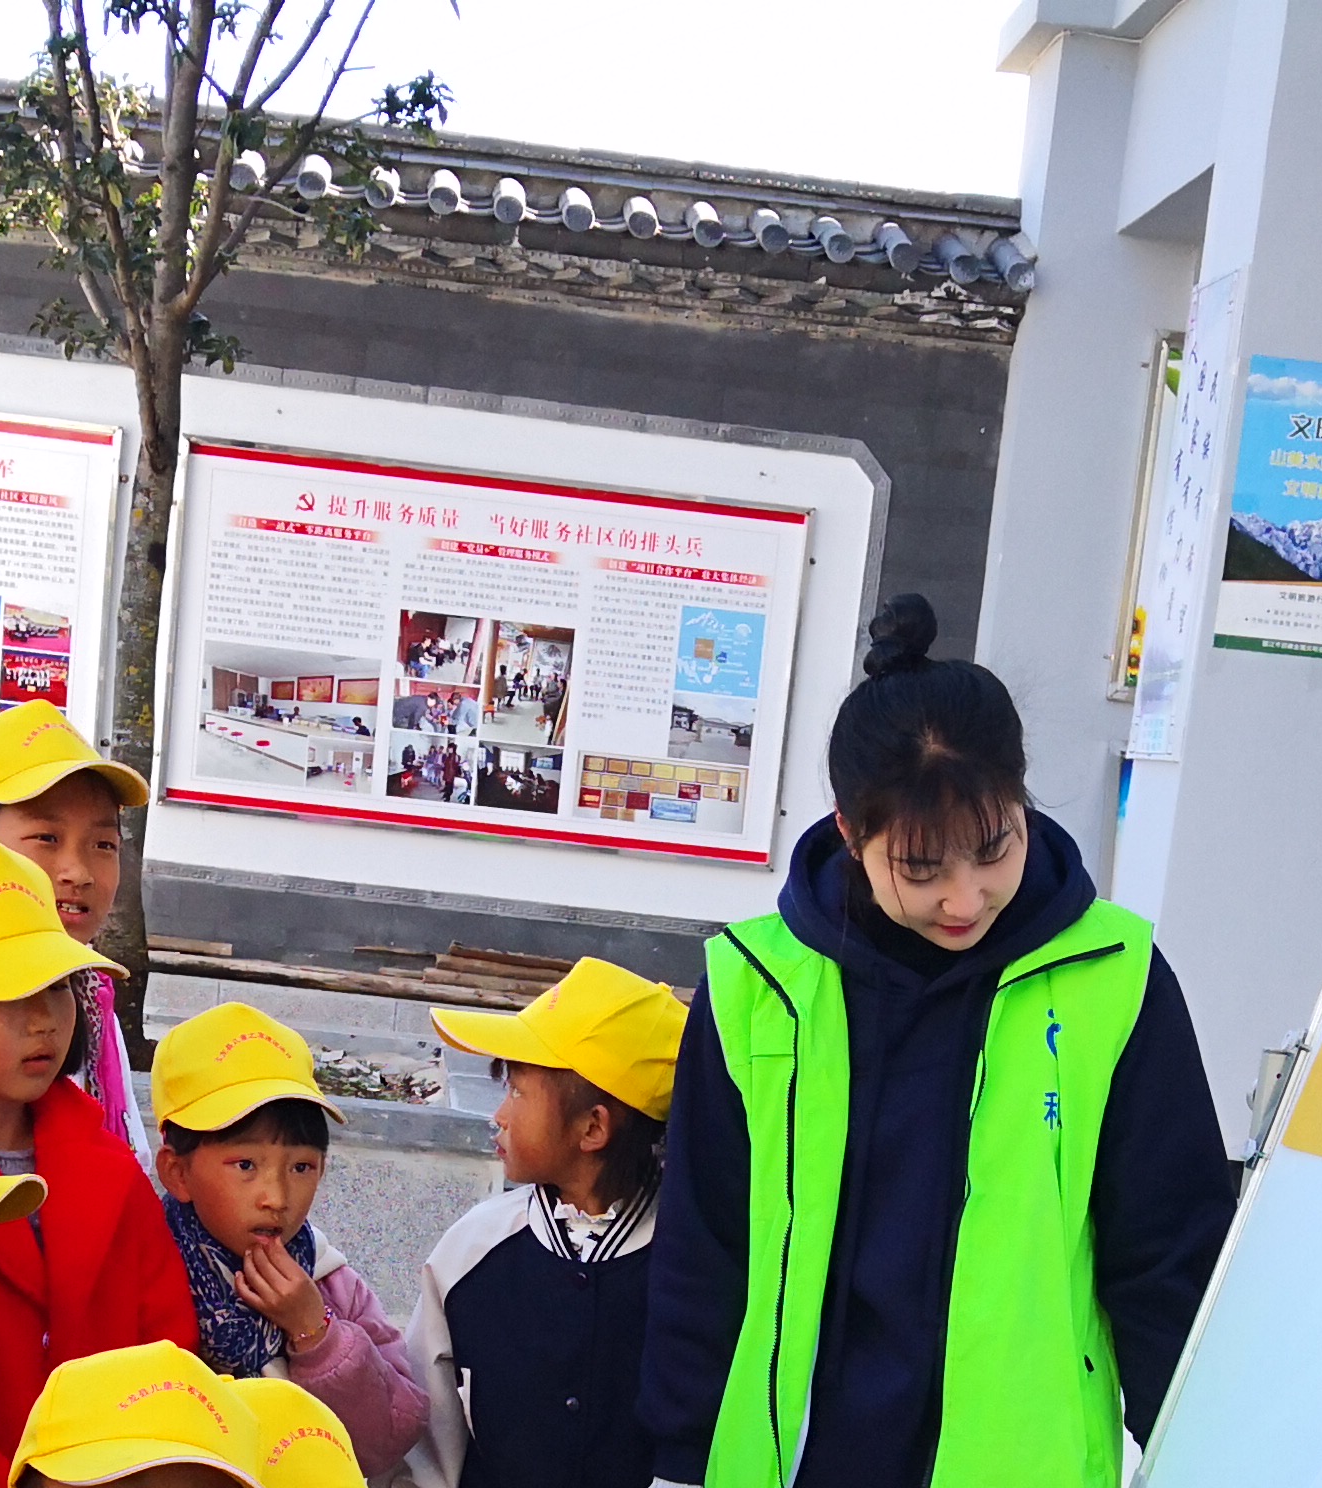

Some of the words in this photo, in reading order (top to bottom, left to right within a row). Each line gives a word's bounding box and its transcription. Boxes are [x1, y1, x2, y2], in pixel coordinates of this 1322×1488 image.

[328, 494, 460, 529] 提升服务质量
[491, 514, 703, 558] 当好服务社区的排头兵
